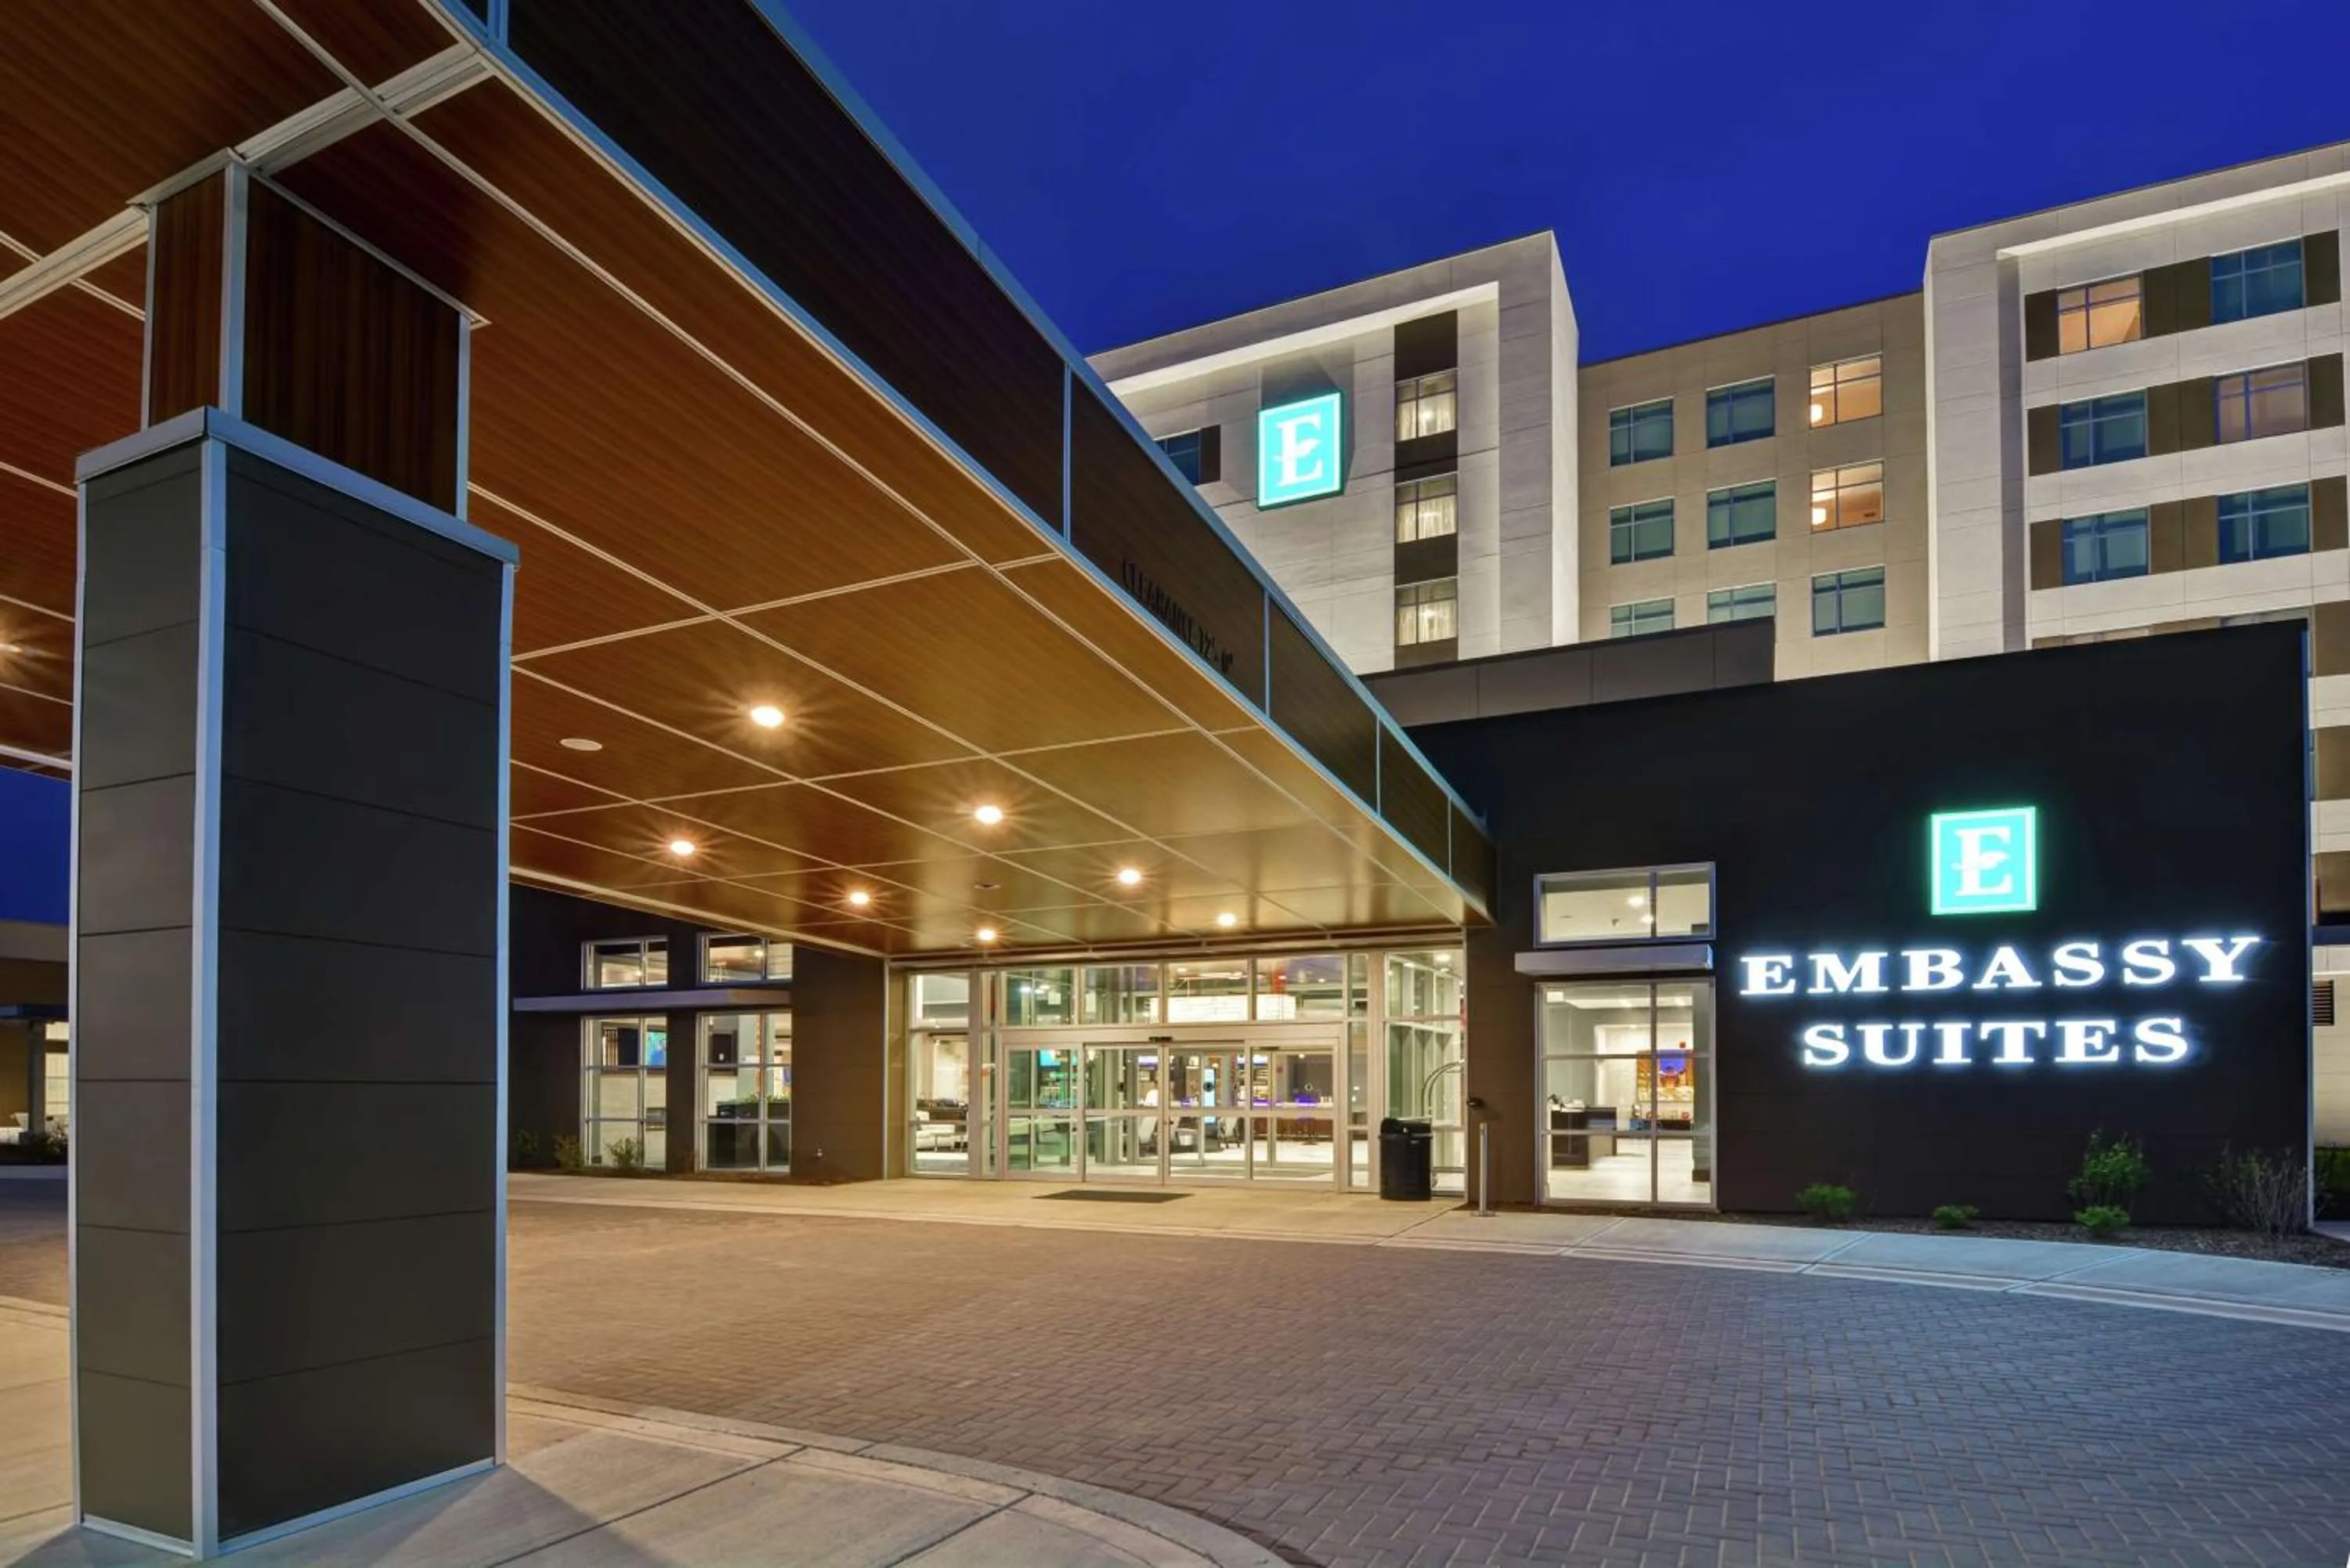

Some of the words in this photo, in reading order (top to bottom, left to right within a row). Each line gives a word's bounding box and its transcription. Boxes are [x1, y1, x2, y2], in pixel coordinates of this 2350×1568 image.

[1274, 412, 1324, 487] E
[1953, 825, 2014, 897] E
[1739, 936, 2261, 995] EMBASSY
[1802, 1017, 2189, 1066] SUITES
